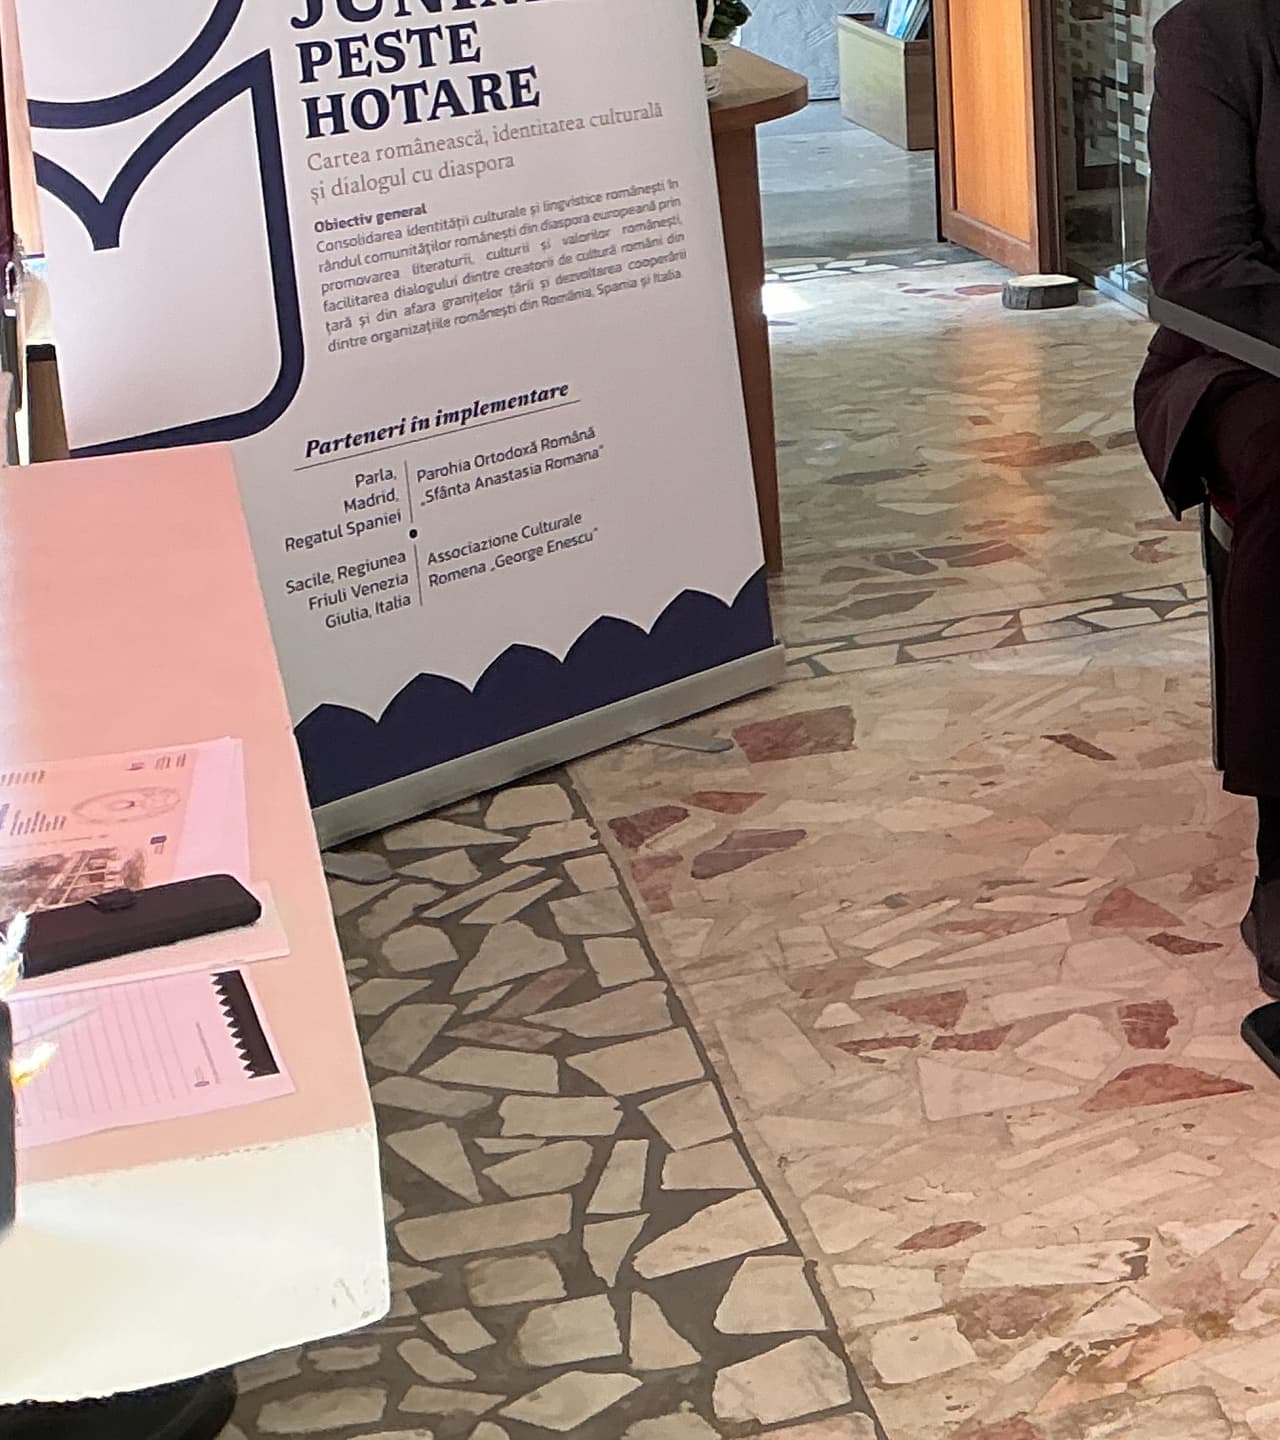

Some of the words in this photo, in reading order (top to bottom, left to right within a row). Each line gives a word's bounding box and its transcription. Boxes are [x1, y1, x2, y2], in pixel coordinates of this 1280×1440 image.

[295, 21, 481, 83] PESTE
[301, 65, 541, 139] HOTARE
[307, 147, 370, 172] Cartea
[376, 131, 490, 161] românească,
[493, 112, 586, 142] identitatea
[590, 101, 664, 129] culturală
[310, 181, 326, 205] și
[331, 169, 407, 198] dialogul
[412, 167, 433, 183] cu
[438, 151, 516, 180] diaspora
[314, 213, 372, 233] Obiectiv
[376, 203, 427, 224] general
[316, 228, 403, 254] Consolidarea
[407, 216, 470, 236] identității
[472, 205, 527, 226] culturale
[543, 193, 603, 213] lingvistice
[668, 178, 679, 189] în
[318, 252, 362, 273] rândul
[364, 240, 452, 265] comunităților
[519, 222, 538, 236] din
[540, 214, 590, 232] diaspora
[592, 203, 656, 222] europeană
[658, 197, 681, 212] prin
[321, 269, 400, 296] promovarea
[486, 243, 530, 262] culturii
[562, 229, 611, 246] valorilor
[323, 290, 389, 313] facilitarea
[393, 277, 458, 299] dialogului
[462, 268, 499, 285] dintre
[558, 253, 572, 266] de
[576, 245, 617, 262] cultură
[621, 237, 663, 253] români
[667, 232, 685, 245] din
[325, 318, 352, 335] țară
[359, 315, 370, 329] și
[376, 308, 398, 323] din
[403, 301, 436, 317] afara
[441, 288, 503, 312] granițelor
[555, 263, 622, 286] dezvoltarea
[628, 248, 687, 270] cooperării
[327, 334, 368, 352] dintre
[371, 317, 451, 343] organizațiile
[519, 299, 538, 312] din
[596, 278, 637, 297] Spania
[653, 270, 682, 284] Italia
[305, 417, 407, 457] Parteneri
[410, 413, 431, 433] în
[435, 383, 569, 428] implementare
[343, 489, 399, 513] Madrid,
[474, 462, 542, 490] Anastasia
[355, 468, 398, 488] Parla,
[417, 460, 471, 483] Parohia
[474, 442, 538, 468] Ortodoxă
[541, 426, 596, 451] Română
[284, 525, 343, 553] Regatul
[346, 509, 402, 538] Spaniei
[427, 532, 518, 566] Associazione
[521, 512, 582, 540] Culturale
[286, 569, 335, 594] Sacile,
[337, 551, 407, 581] Regiunea
[308, 589, 348, 611] Friuli
[351, 572, 409, 599] Venezia
[428, 562, 486, 588] Romena
[325, 605, 372, 629] Giulia,
[375, 594, 411, 617] Italia
